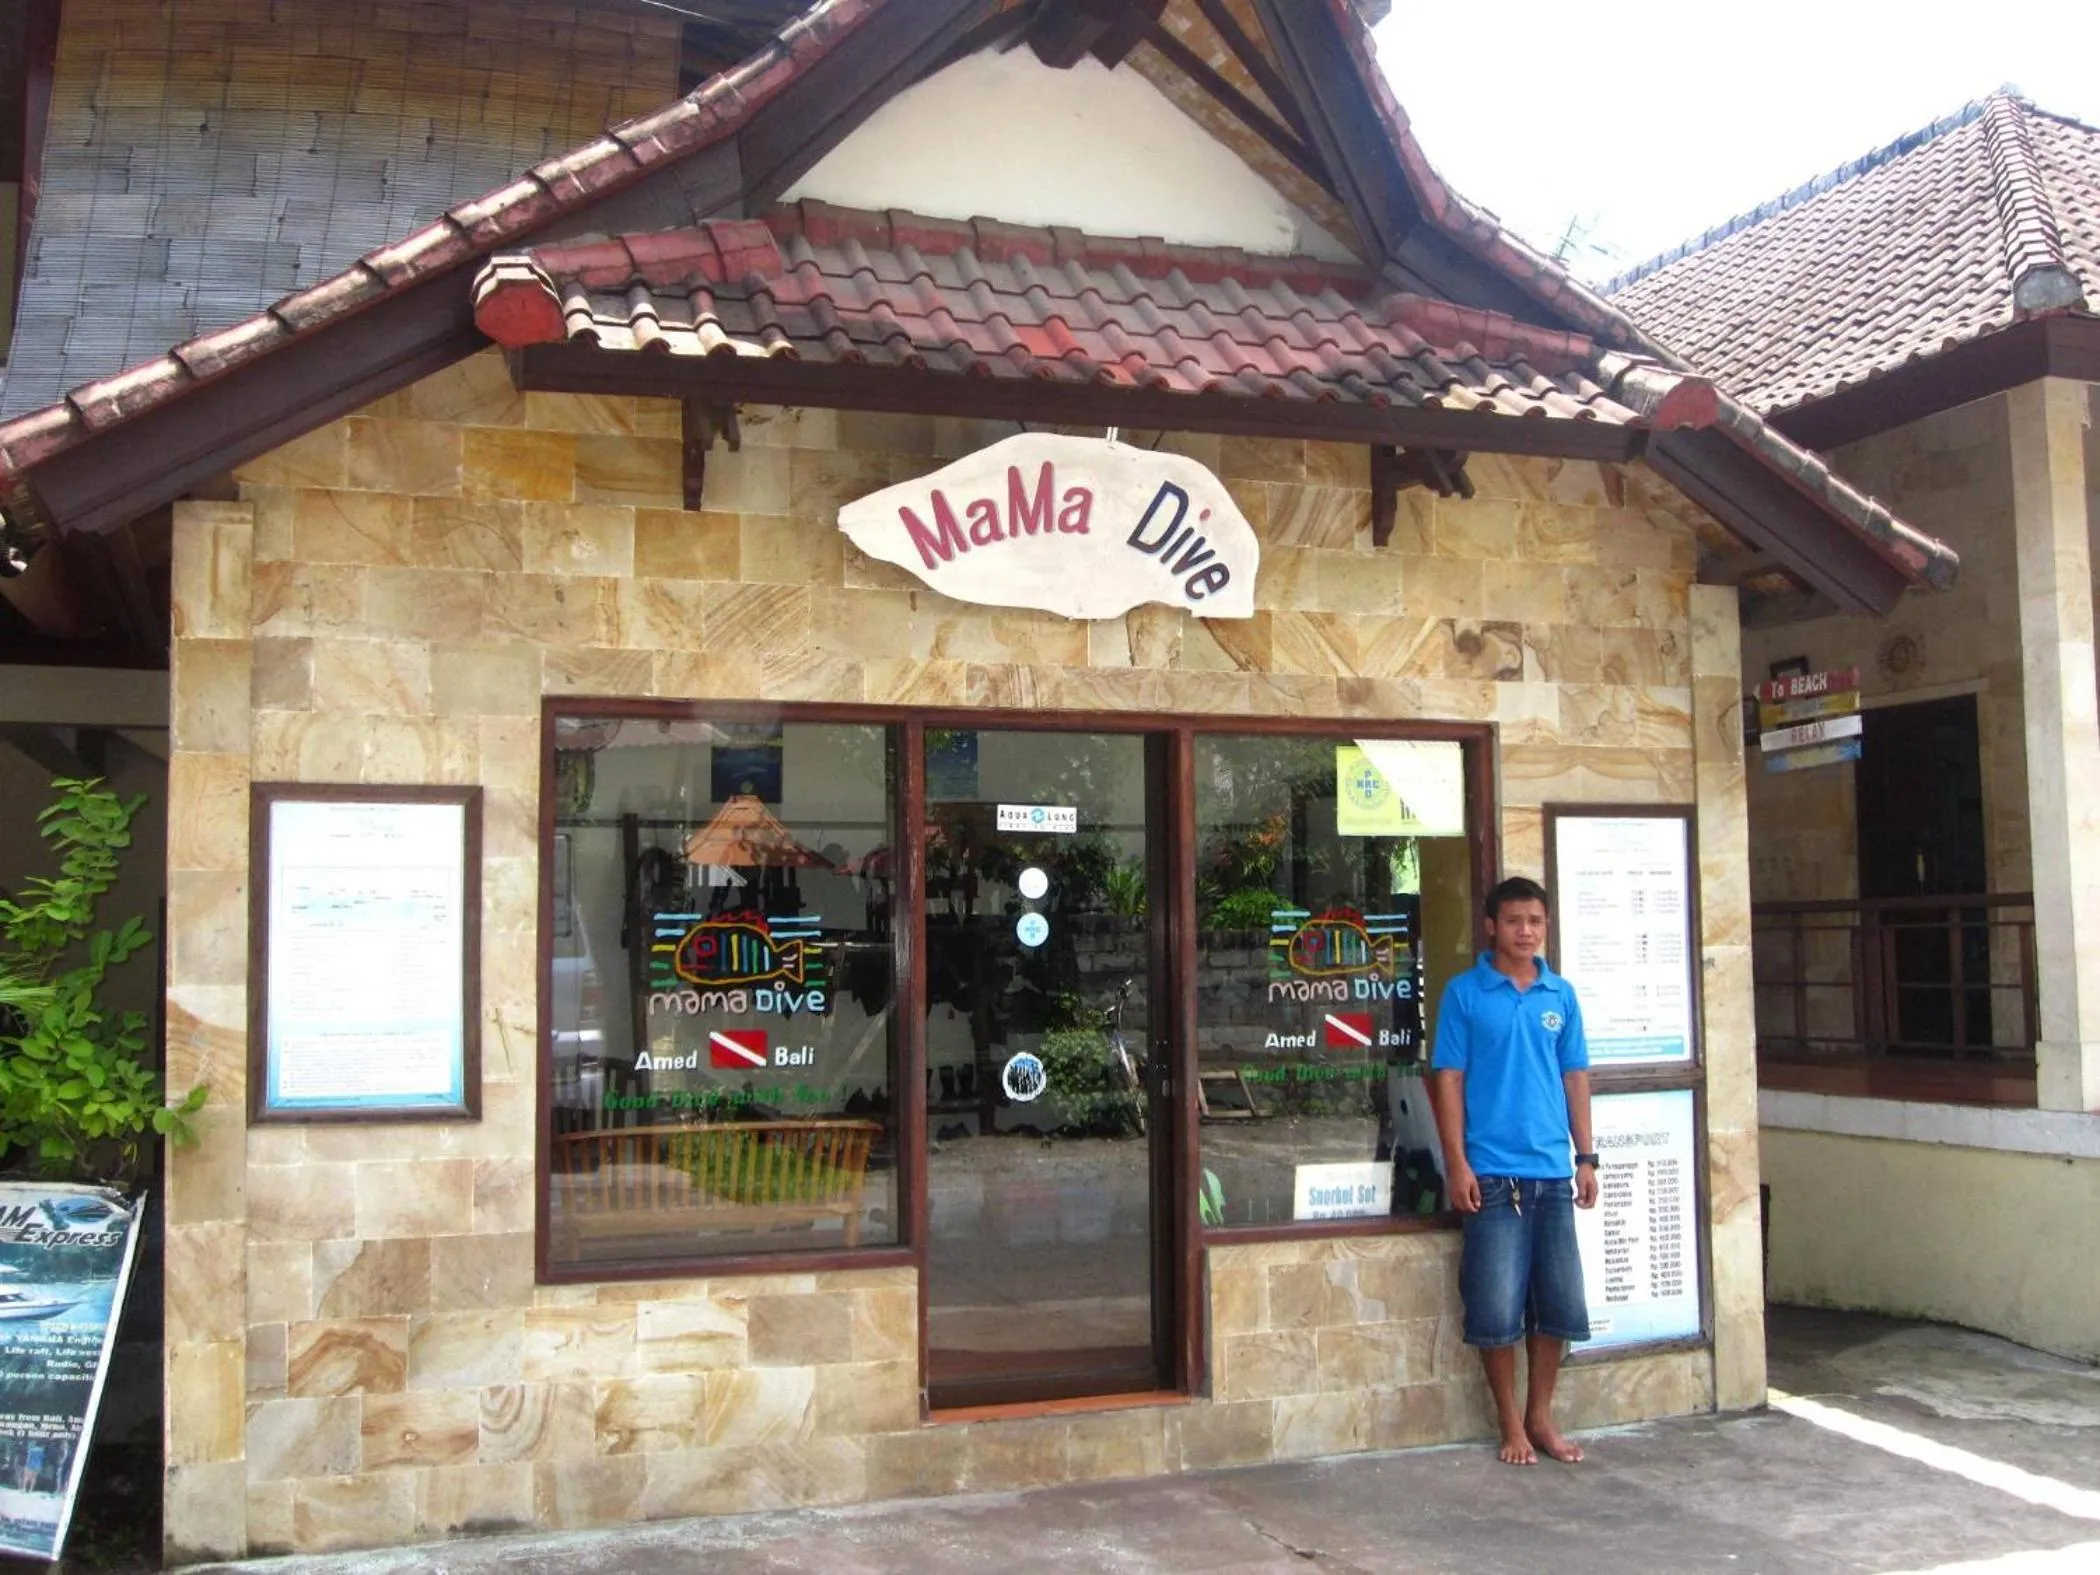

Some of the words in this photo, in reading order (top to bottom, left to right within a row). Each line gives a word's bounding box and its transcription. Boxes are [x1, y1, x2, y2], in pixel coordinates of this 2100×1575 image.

[899, 460, 1095, 570] MaMa
[1126, 480, 1231, 601] Dive
[1791, 672, 1828, 695] BEACH
[649, 989, 747, 1015] mama
[755, 981, 826, 1014] Dive
[1268, 979, 1349, 1003] mama
[1354, 973, 1412, 1000] Dive
[1265, 1030, 1316, 1048] Amed
[1379, 1029, 1411, 1046] Bali
[635, 1050, 698, 1070] Amed
[775, 1046, 815, 1066] Bali
[1358, 1184, 1376, 1204] Set
[14, 1222, 122, 1251] Express
